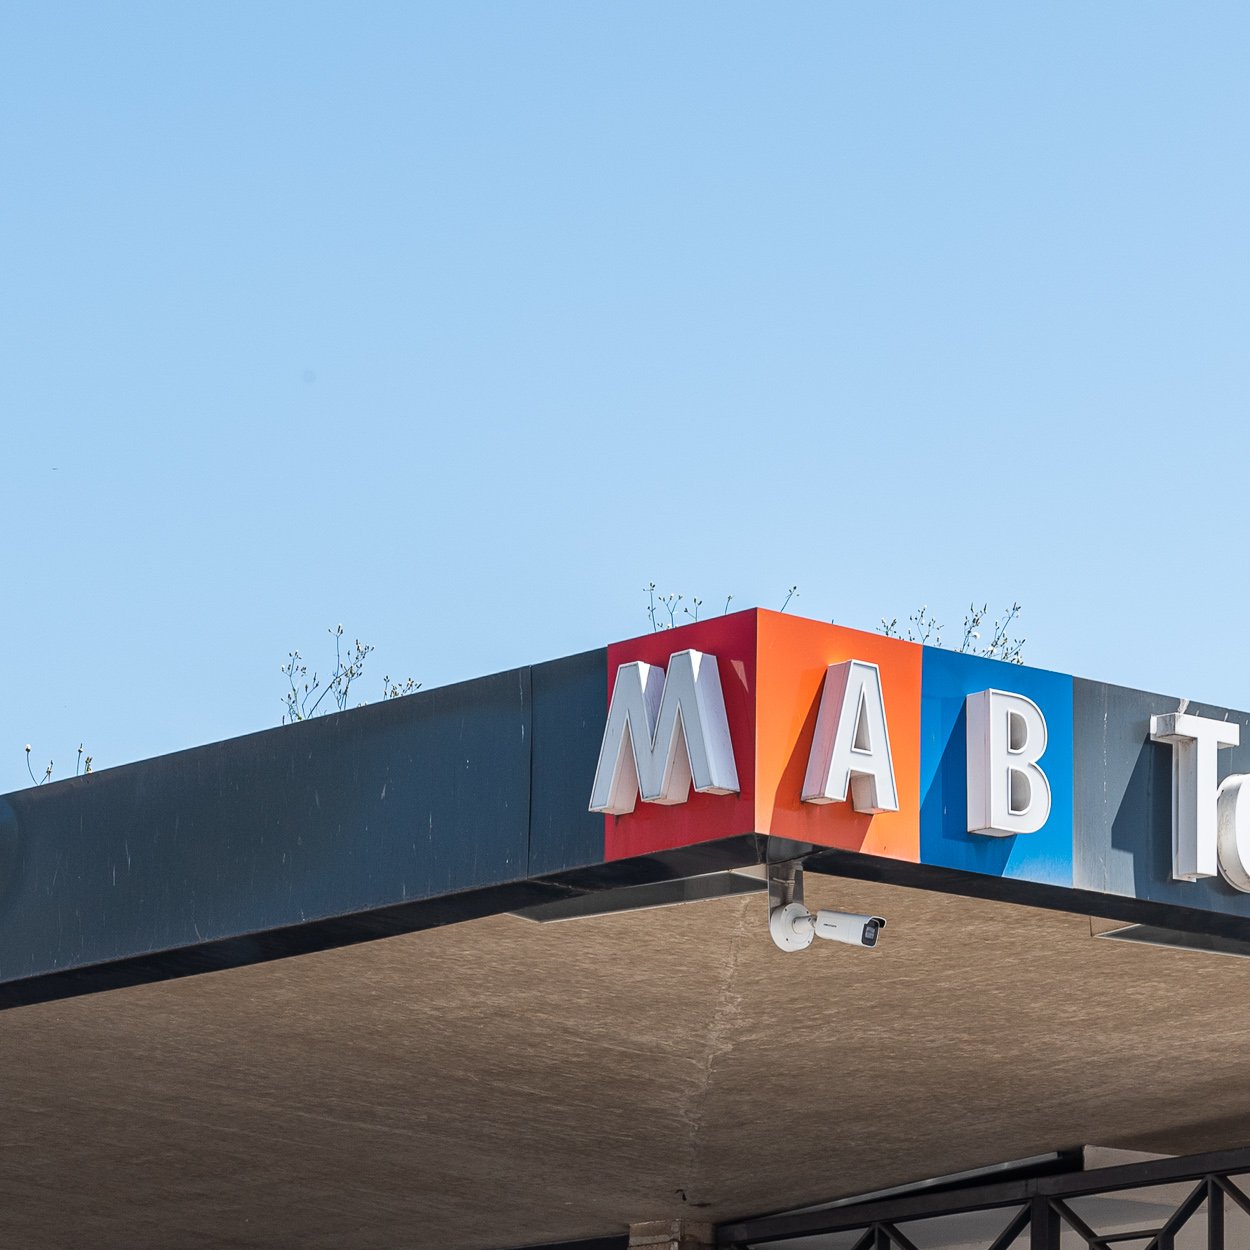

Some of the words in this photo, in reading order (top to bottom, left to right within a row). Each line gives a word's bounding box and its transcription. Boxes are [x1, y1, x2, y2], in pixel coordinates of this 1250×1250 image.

[589, 648, 740, 816] M
[800, 658, 901, 814] A
[965, 687, 1051, 838] B
